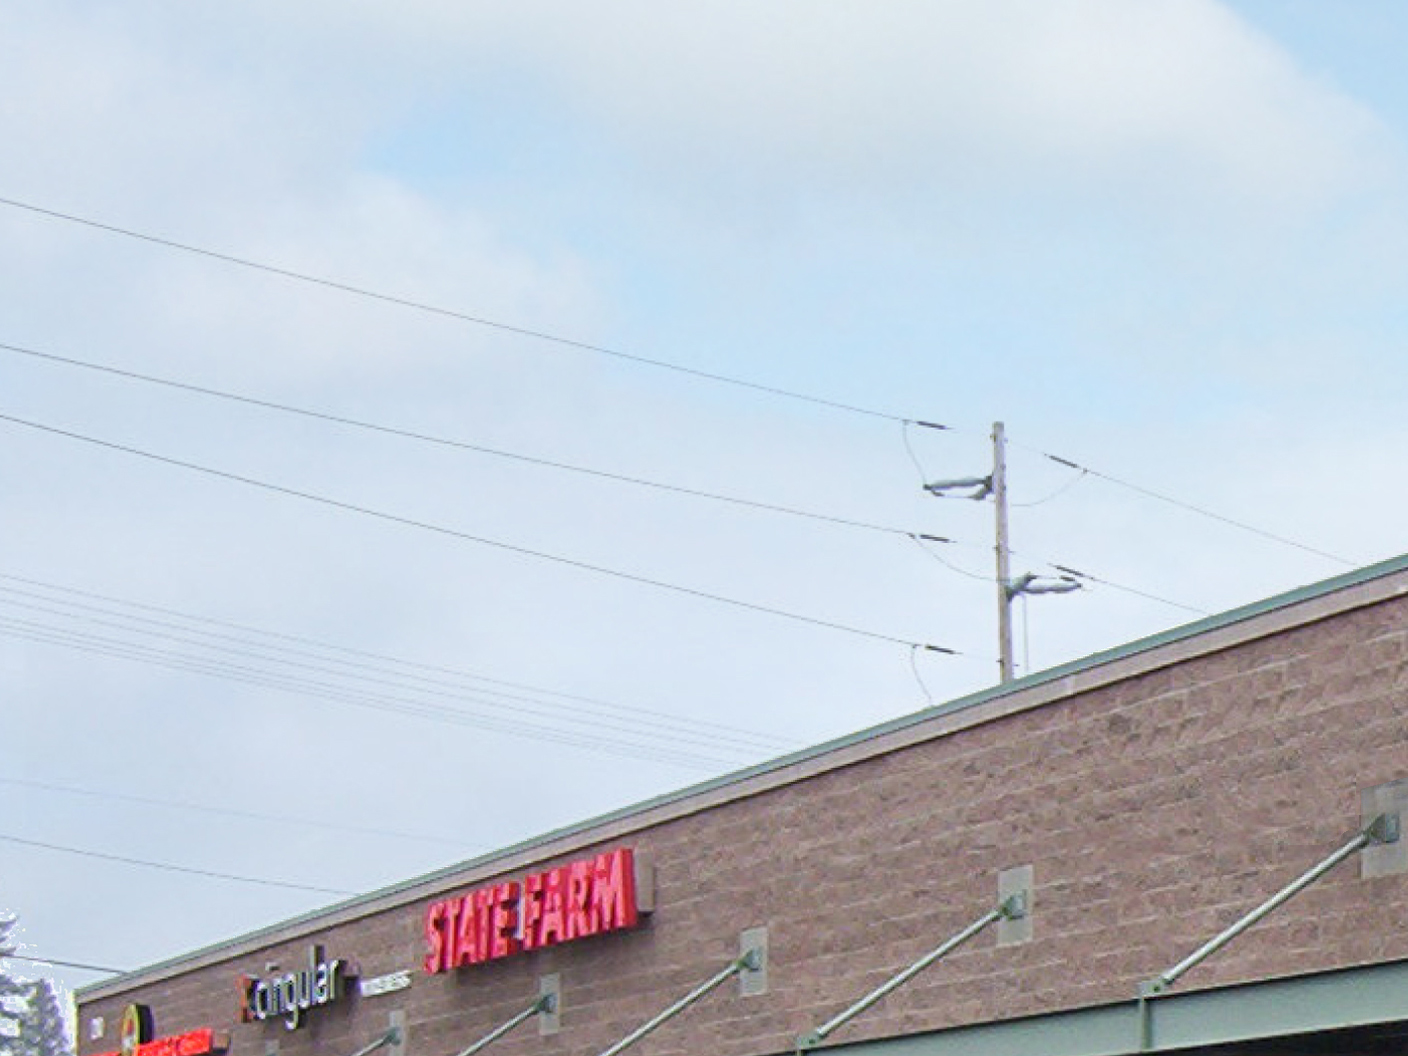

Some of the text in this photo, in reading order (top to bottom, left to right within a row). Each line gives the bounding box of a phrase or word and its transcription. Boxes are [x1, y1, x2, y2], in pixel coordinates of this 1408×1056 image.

[423, 848, 637, 975] STATE FARM
[255, 945, 342, 1031] cingular
